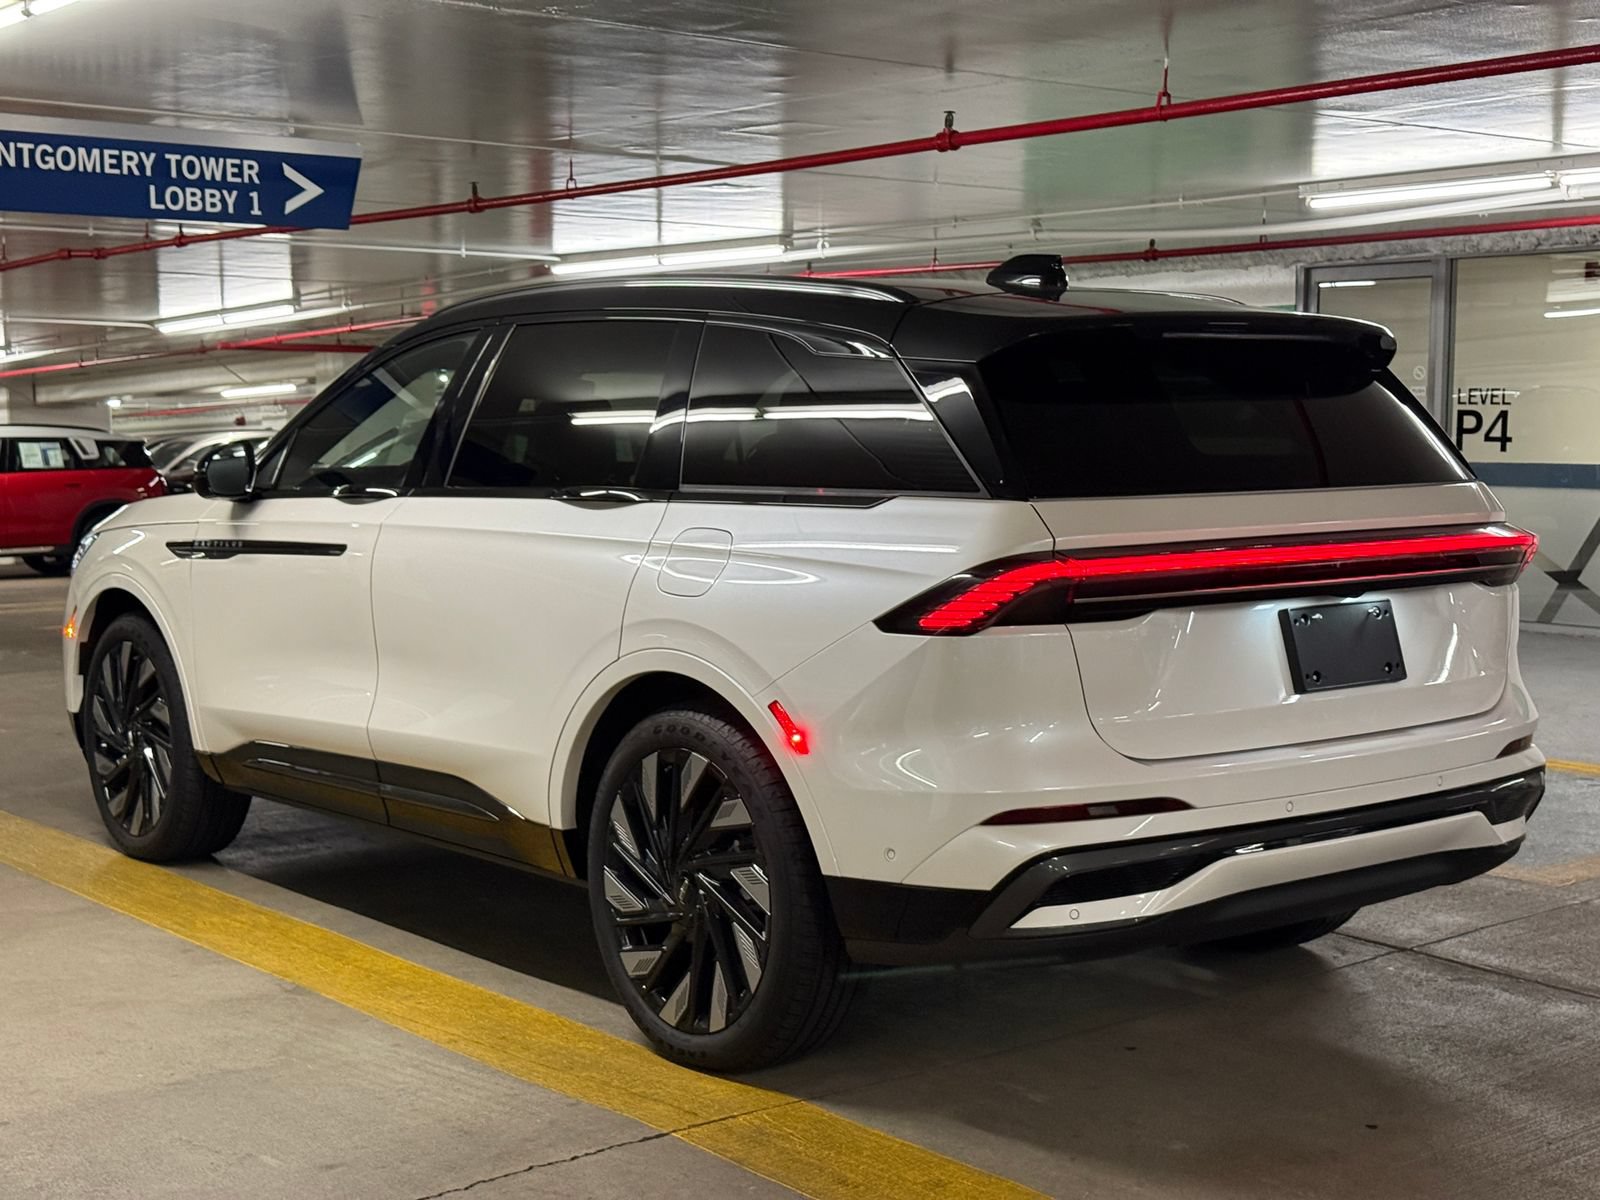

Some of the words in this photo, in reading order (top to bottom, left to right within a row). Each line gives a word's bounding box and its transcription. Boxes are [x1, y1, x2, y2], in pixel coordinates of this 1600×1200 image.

[165, 153, 260, 184] TOWER
[150, 185, 237, 214] LOBBY
[249, 191, 262, 216] 1
[1457, 388, 1512, 405] LEVEL
[1456, 409, 1513, 452] P4
